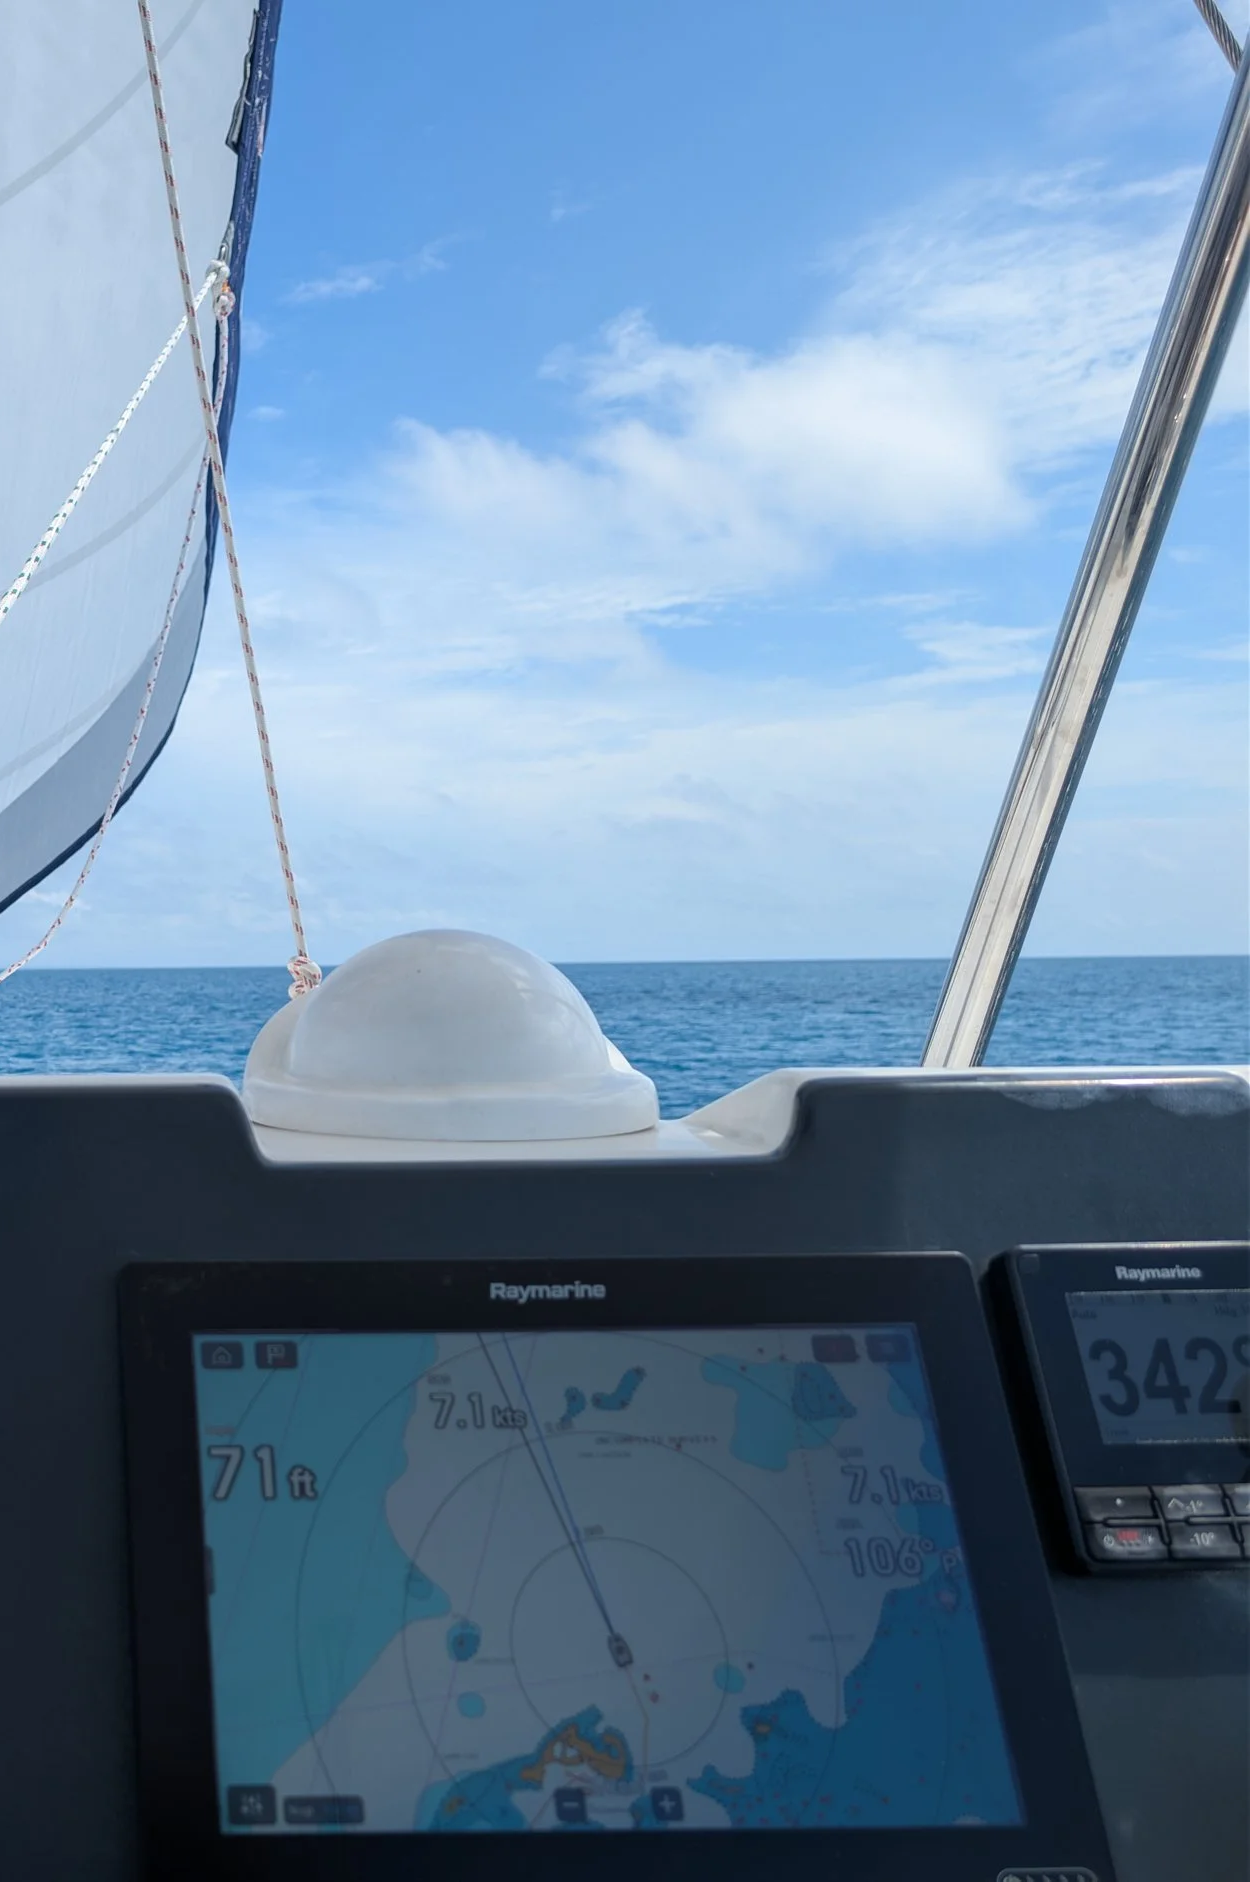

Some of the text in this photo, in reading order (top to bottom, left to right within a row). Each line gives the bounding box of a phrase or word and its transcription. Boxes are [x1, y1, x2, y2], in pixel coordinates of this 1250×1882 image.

[489, 1280, 607, 1305] Raymarine
[1114, 1264, 1202, 1283] Raymarine
[429, 1391, 527, 1429] 7.1 kts
[207, 1444, 318, 1501] 71 ft
[840, 1465, 944, 1505] 7.1 kts
[843, 1537, 935, 1578] 106°
